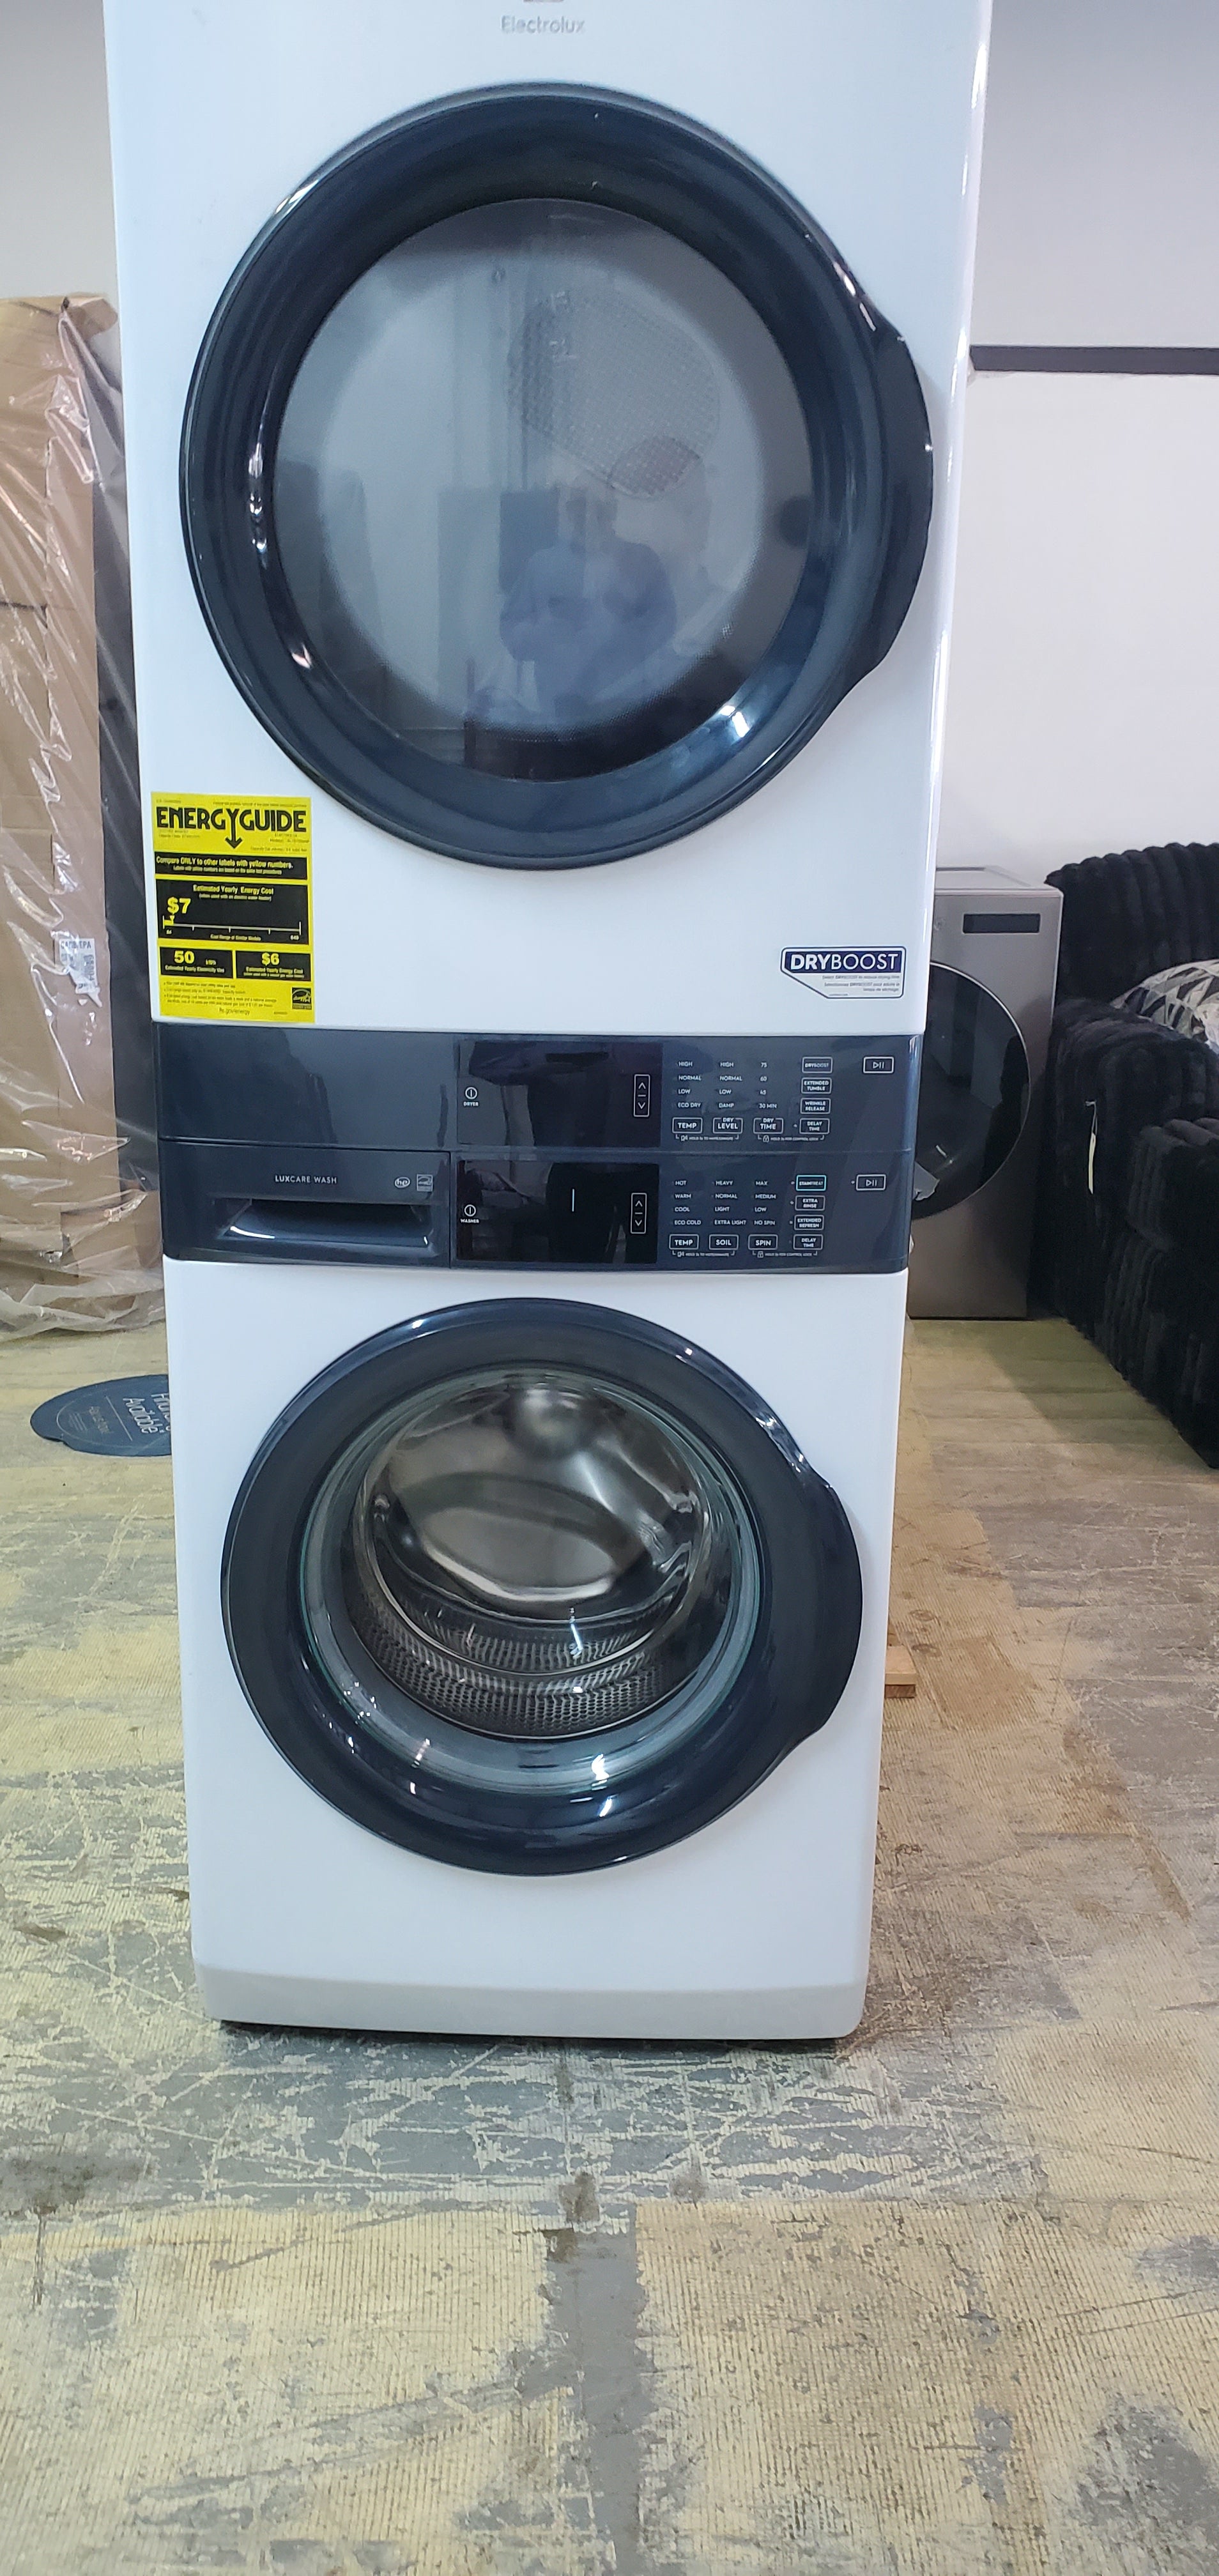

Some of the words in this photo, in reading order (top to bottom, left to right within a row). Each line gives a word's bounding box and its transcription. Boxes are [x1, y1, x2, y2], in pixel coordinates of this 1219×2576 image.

[501, 15, 585, 34] Electrolux
[155, 806, 307, 833] ENERGYGUIDE
[180, 857, 196, 865] ONLY
[167, 897, 191, 914] $7
[174, 950, 195, 963] 50
[261, 952, 280, 966] $6
[790, 953, 899, 970] DRYBOOST
[275, 1175, 310, 1183] LUXCARE
[314, 1176, 337, 1184] WASH
